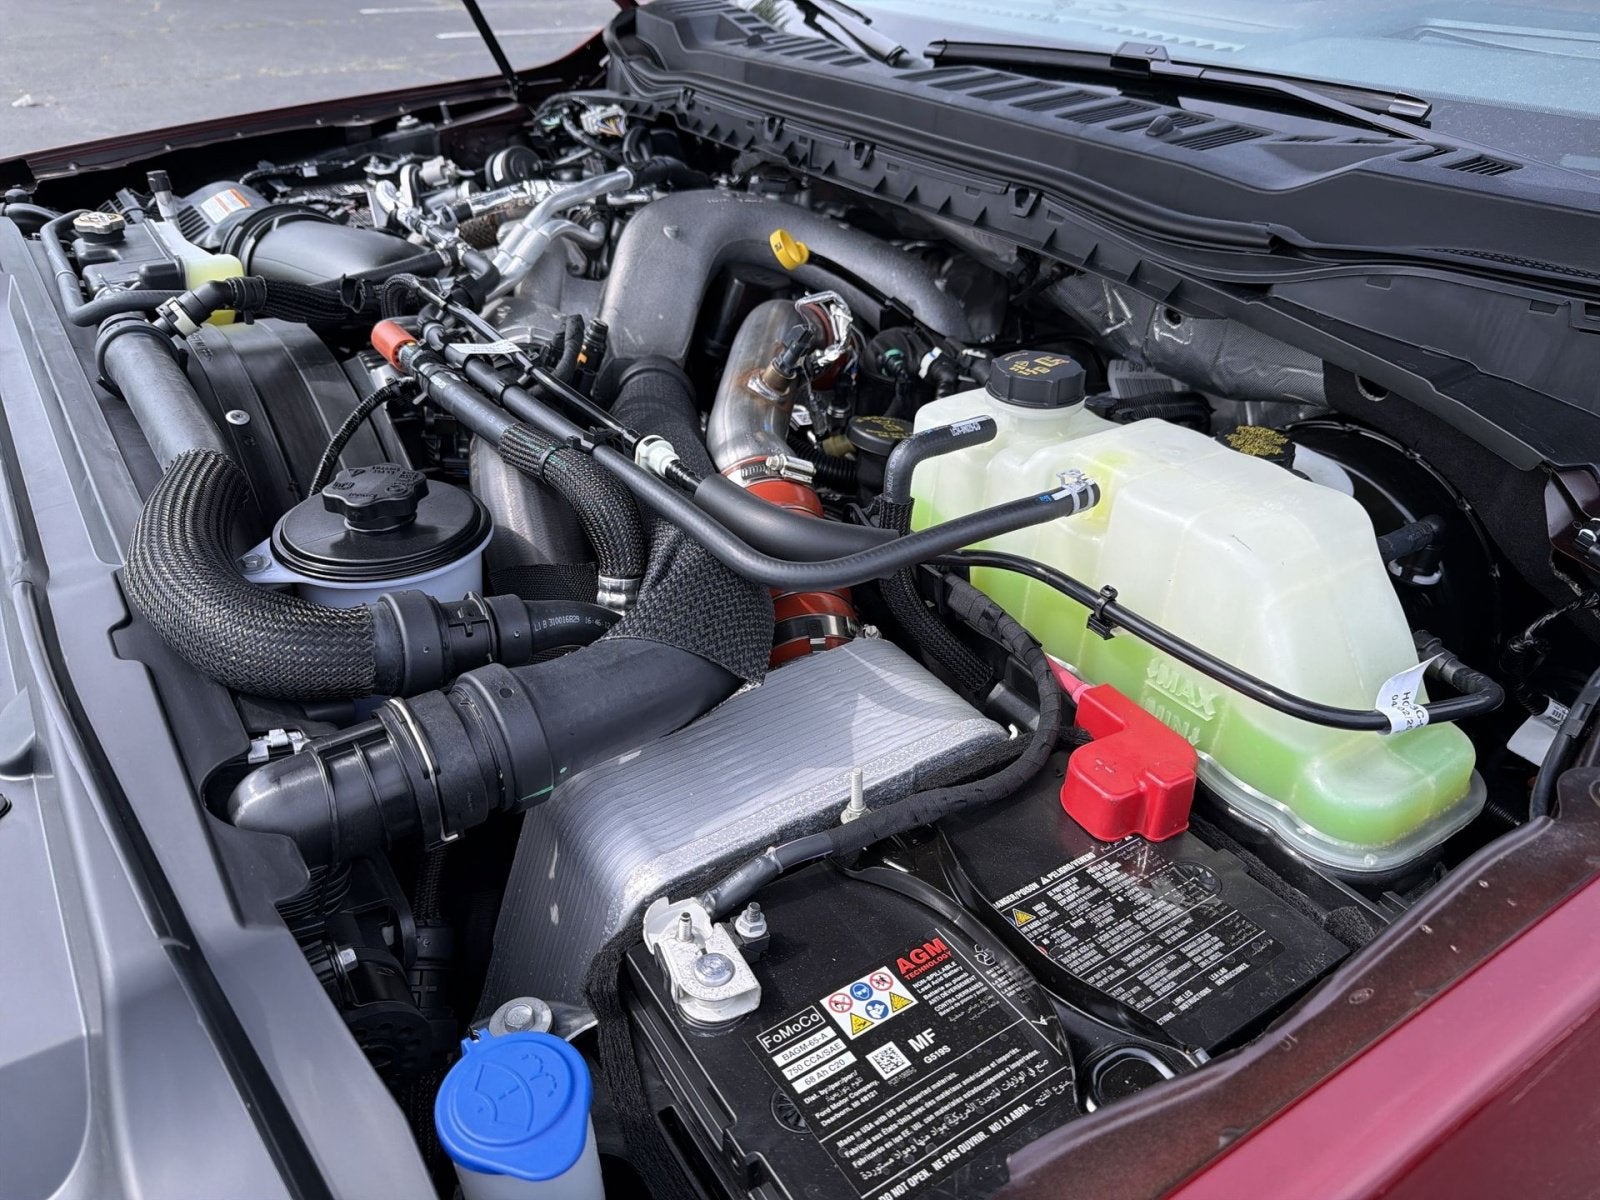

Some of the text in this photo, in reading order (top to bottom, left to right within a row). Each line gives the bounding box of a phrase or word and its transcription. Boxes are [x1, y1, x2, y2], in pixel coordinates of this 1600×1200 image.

[1156, 662, 1217, 716] MAX
[1047, 851, 1096, 881] PELIGRO/VENENO
[896, 937, 949, 976] AGM
[904, 950, 953, 981] TECHNOLOGY
[912, 961, 958, 989] NON-SPILLABLE
[916, 965, 964, 994] Lead Acid Battery
[922, 986, 945, 1000] Batterie
[951, 972, 969, 985] plomb
[928, 995, 942, 1006] ANTI
[761, 1013, 820, 1048] FoMoCo
[907, 1028, 936, 1053] MF
[781, 1032, 829, 1061] BAGM-65-A
[786, 1042, 843, 1077] 750 CCA/SAE
[923, 1045, 951, 1064] G519S
[804, 1058, 846, 1086] 68 Ah C20
[1034, 1059, 1049, 1073] صنع
[803, 1093, 820, 1104] Dist.
[814, 1107, 832, 1119] Ford
[829, 1096, 849, 1110] Motor
[836, 1135, 856, 1148] Made
[853, 1130, 862, 1138] in
[860, 1122, 875, 1134] USA
[873, 1115, 888, 1126] with
[885, 1108, 897, 1118] US
[895, 1101, 908, 1113] and
[905, 1086, 933, 1106] imported
[930, 1072, 959, 1090] materials.
[851, 1100, 861, 1108] MI
[860, 1089, 878, 1103] 48121
[844, 1138, 873, 1158] Fabriqué
[871, 1132, 883, 1142] aux
[911, 1105, 926, 1117] avec
[924, 1099, 937, 1109] des
[884, 1141, 894, 1149] en
[891, 1134, 904, 1144] los
[900, 1128, 913, 1138] EE.
[910, 1121, 925, 1131] UU.
[923, 1114, 935, 1124] con
[933, 1096, 964, 1117] materiales
[889, 1182, 910, 1198] NOT
[906, 1169, 933, 1188] OPEN.
[931, 1158, 946, 1171] NE
[942, 1149, 961, 1165] PAS
[957, 1131, 990, 1154] OUVRIR.
[988, 1121, 1002, 1133] NO
[998, 1115, 1013, 1127] LA
[1009, 1103, 1033, 1121] ABRA.
